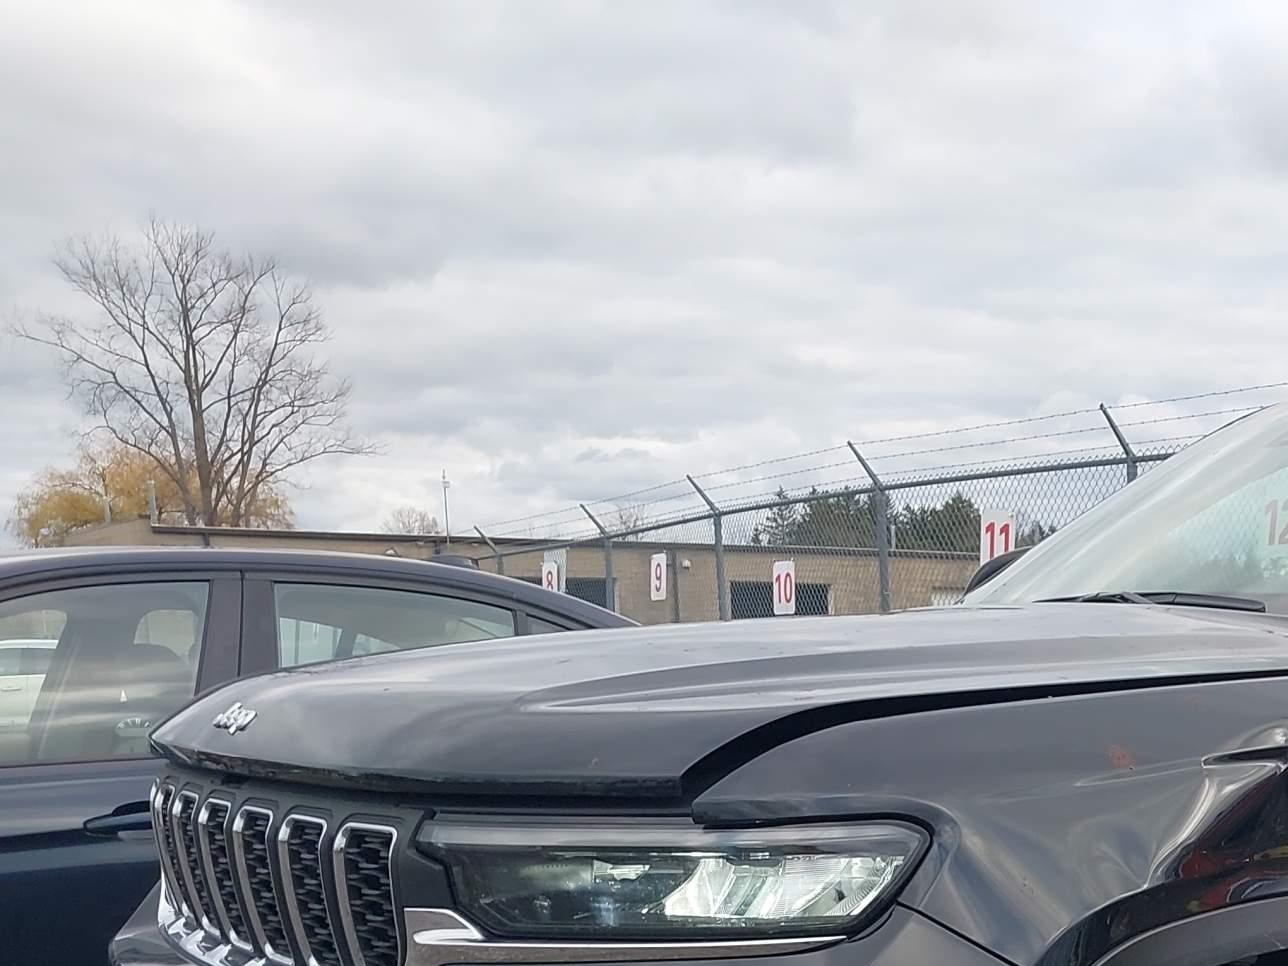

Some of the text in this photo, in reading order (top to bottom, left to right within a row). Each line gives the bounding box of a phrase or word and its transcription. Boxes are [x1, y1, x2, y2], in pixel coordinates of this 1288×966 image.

[985, 522, 1010, 560] 11
[655, 562, 662, 592] 9
[774, 572, 793, 604] 10
